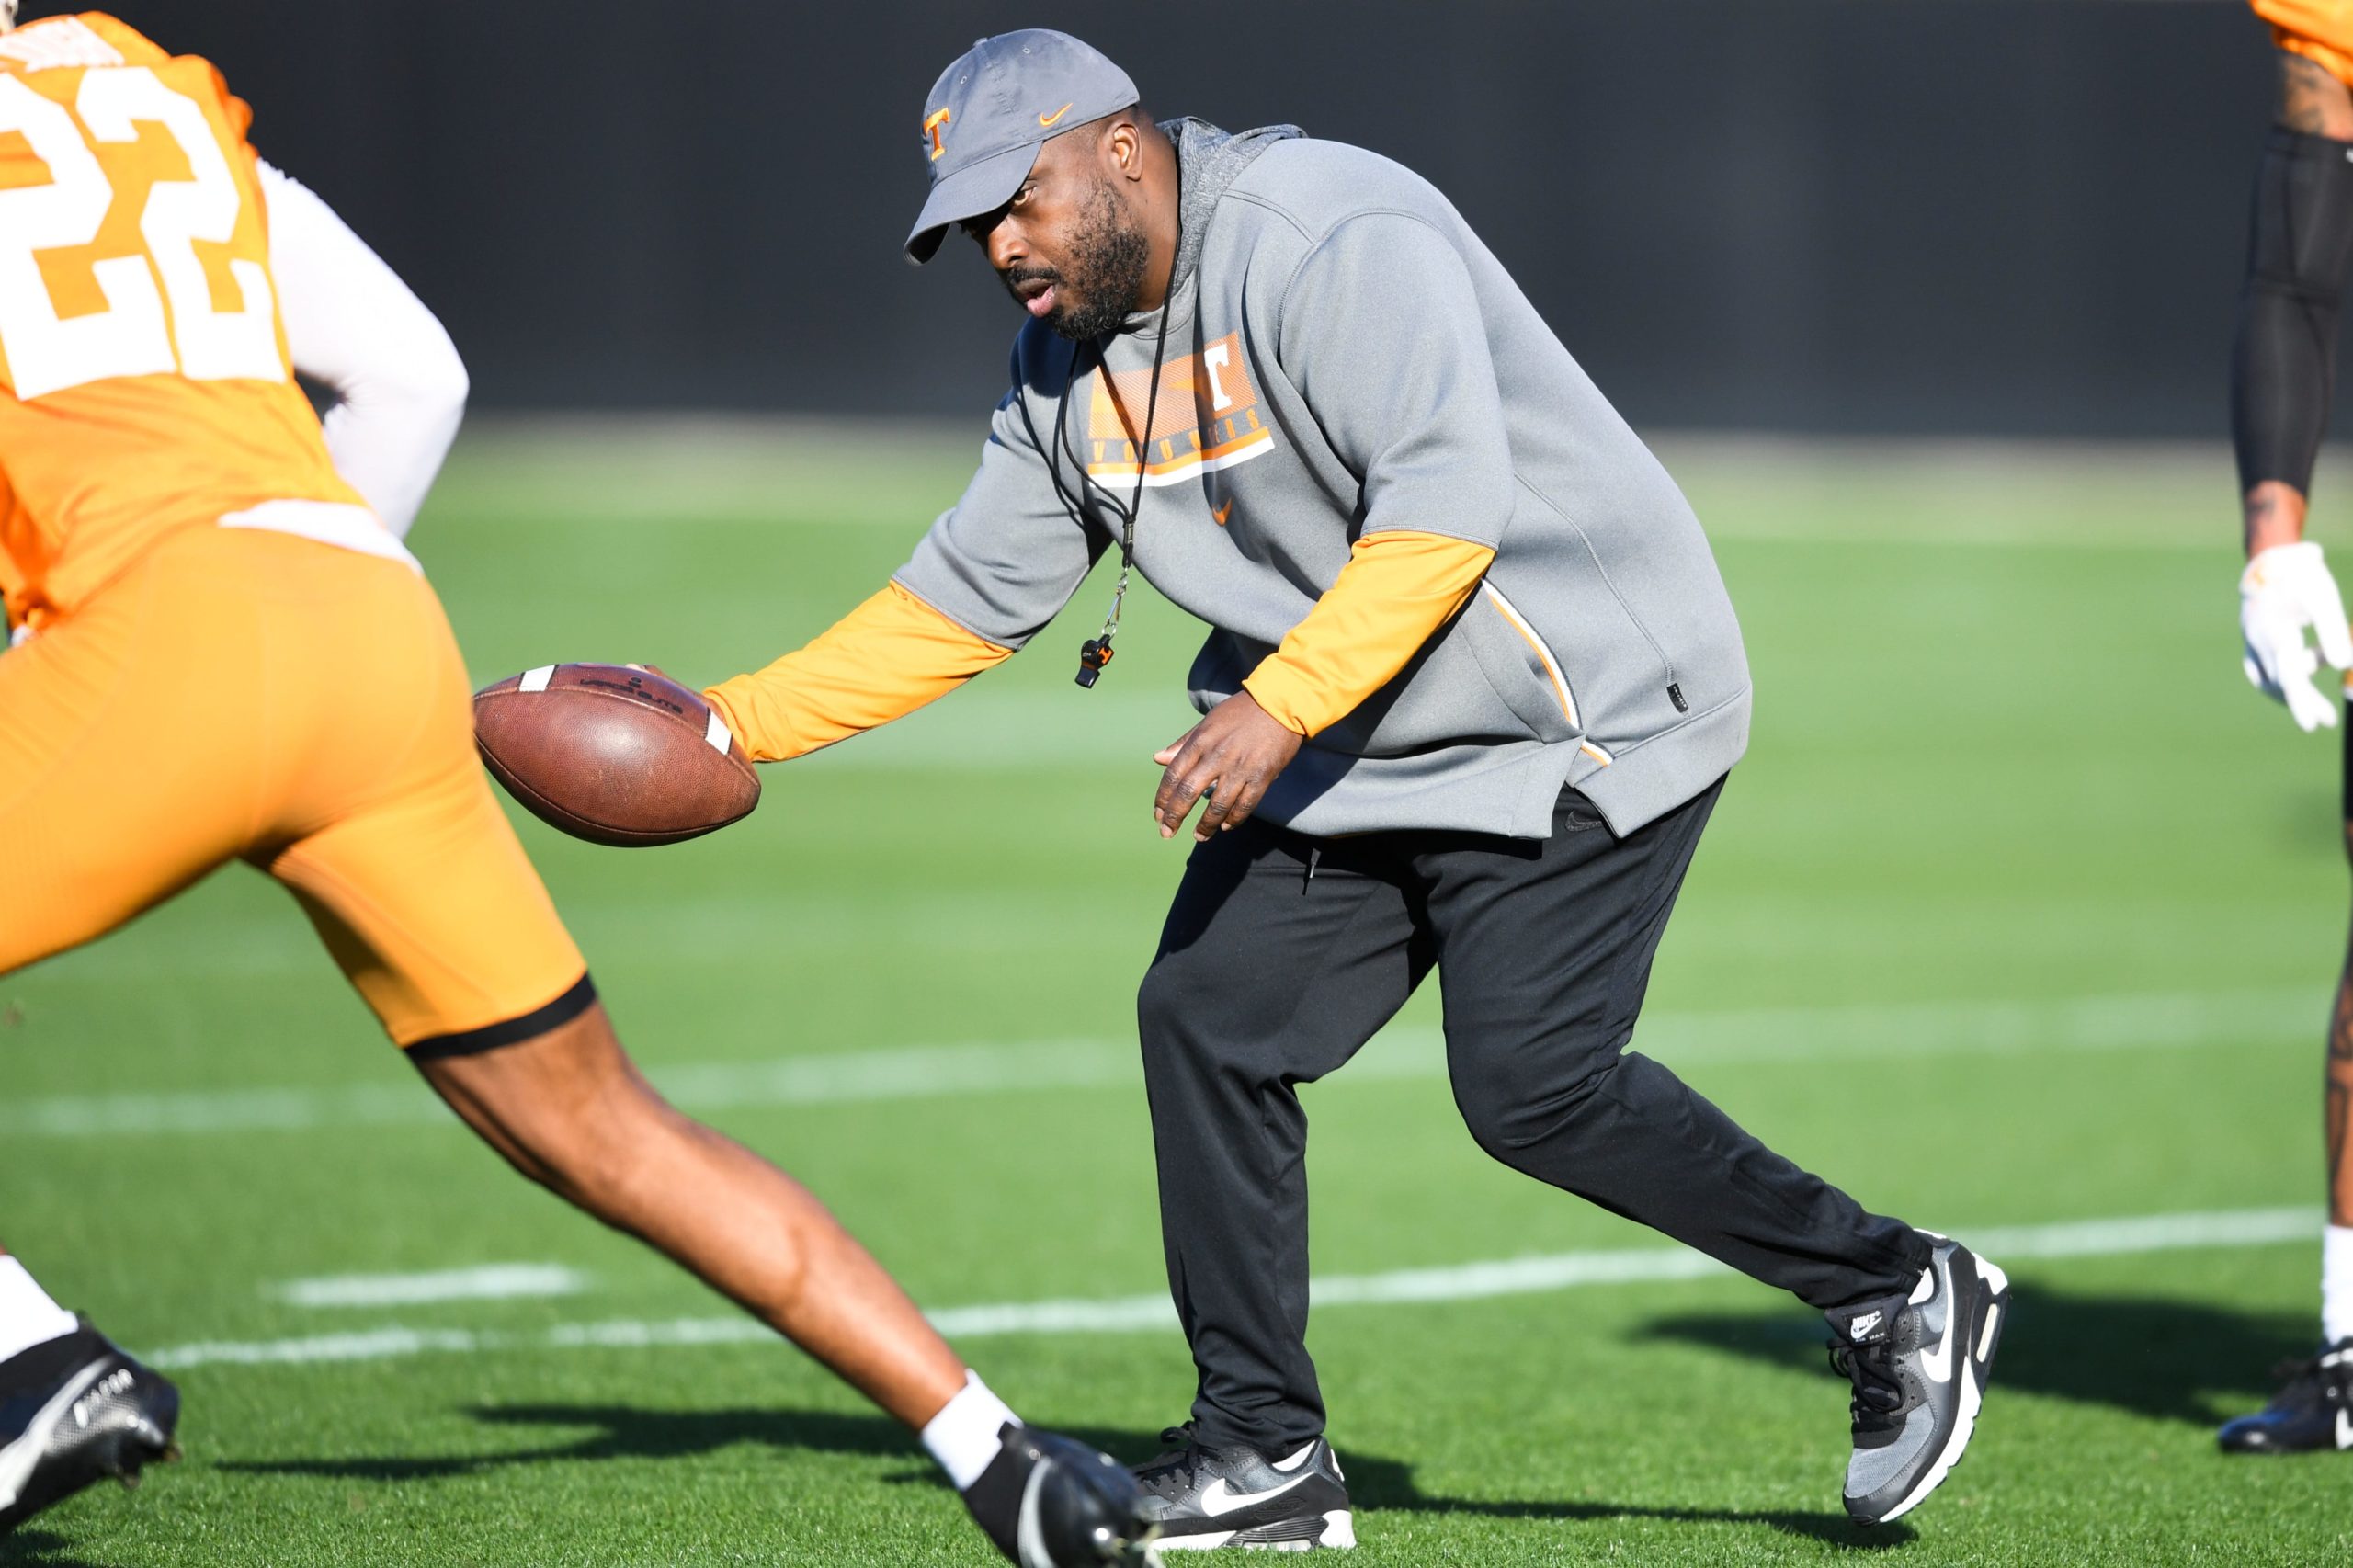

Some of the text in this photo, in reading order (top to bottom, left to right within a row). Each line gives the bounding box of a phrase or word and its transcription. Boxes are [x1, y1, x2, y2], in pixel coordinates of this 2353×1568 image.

[923, 107, 950, 161] T
[0, 66, 288, 402] 22
[1852, 1312, 1876, 1332] NIKE
